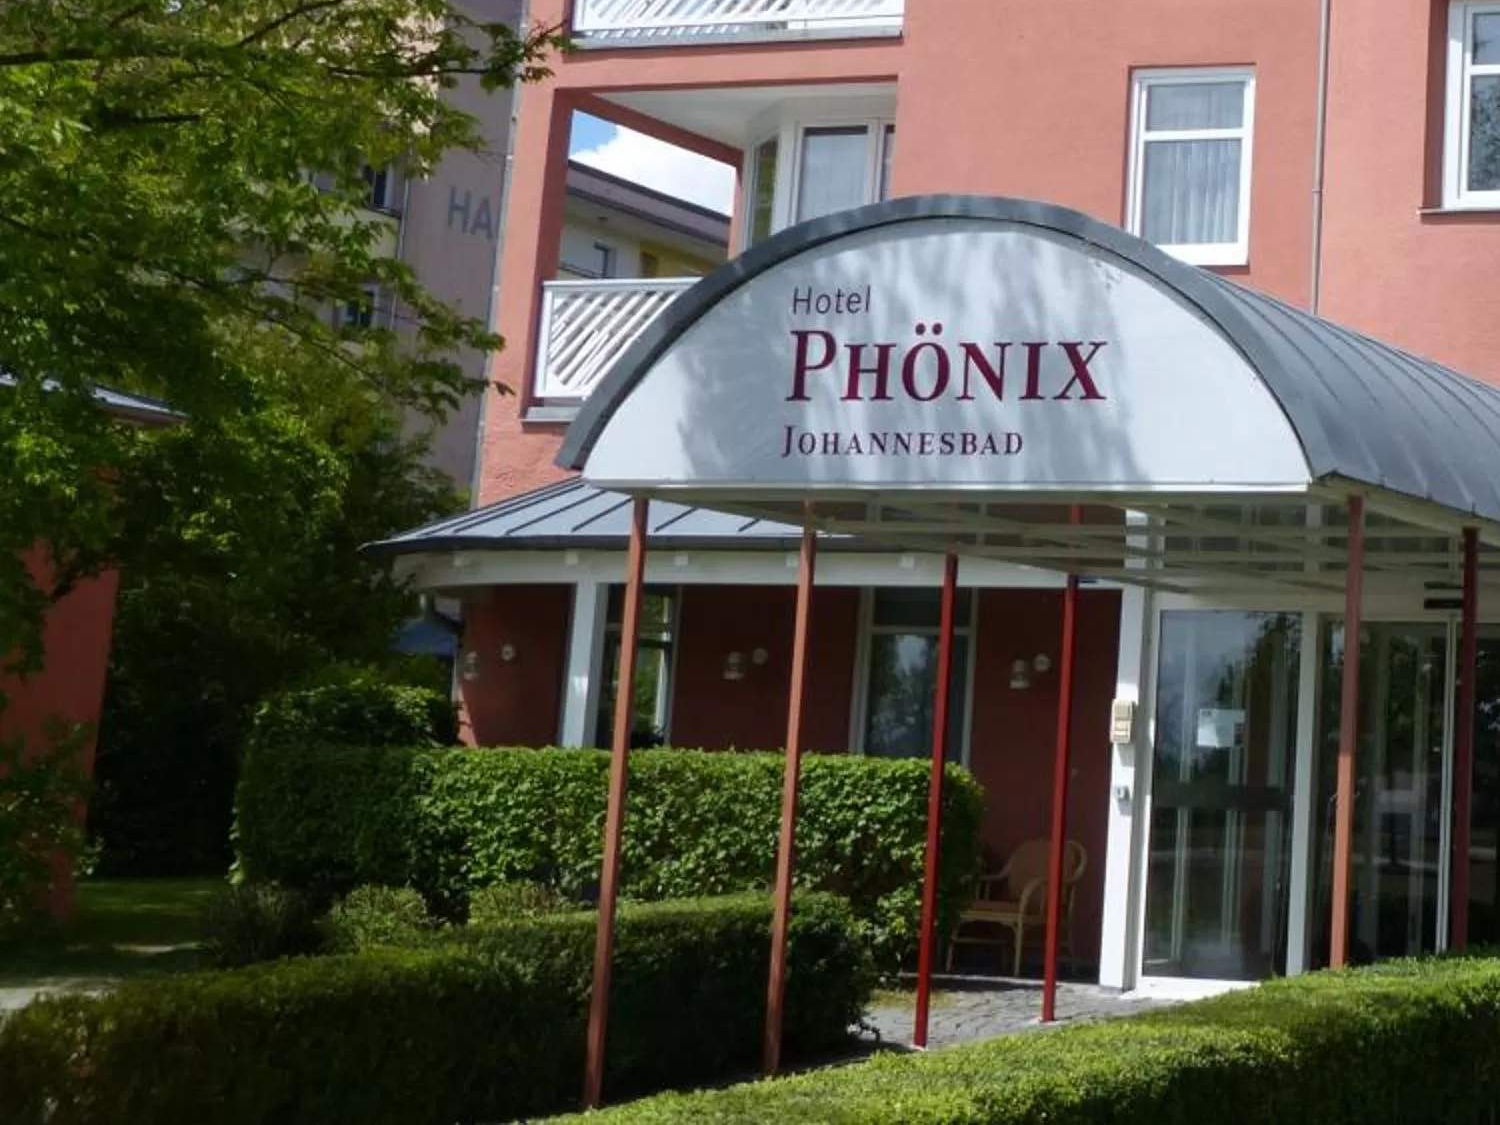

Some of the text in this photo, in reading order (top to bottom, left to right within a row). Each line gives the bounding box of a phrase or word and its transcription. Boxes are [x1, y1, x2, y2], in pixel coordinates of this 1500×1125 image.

[792, 285, 872, 315] Hotel
[784, 322, 1108, 402] PHÖNIX
[782, 425, 1024, 458] JOHANNESBAD
